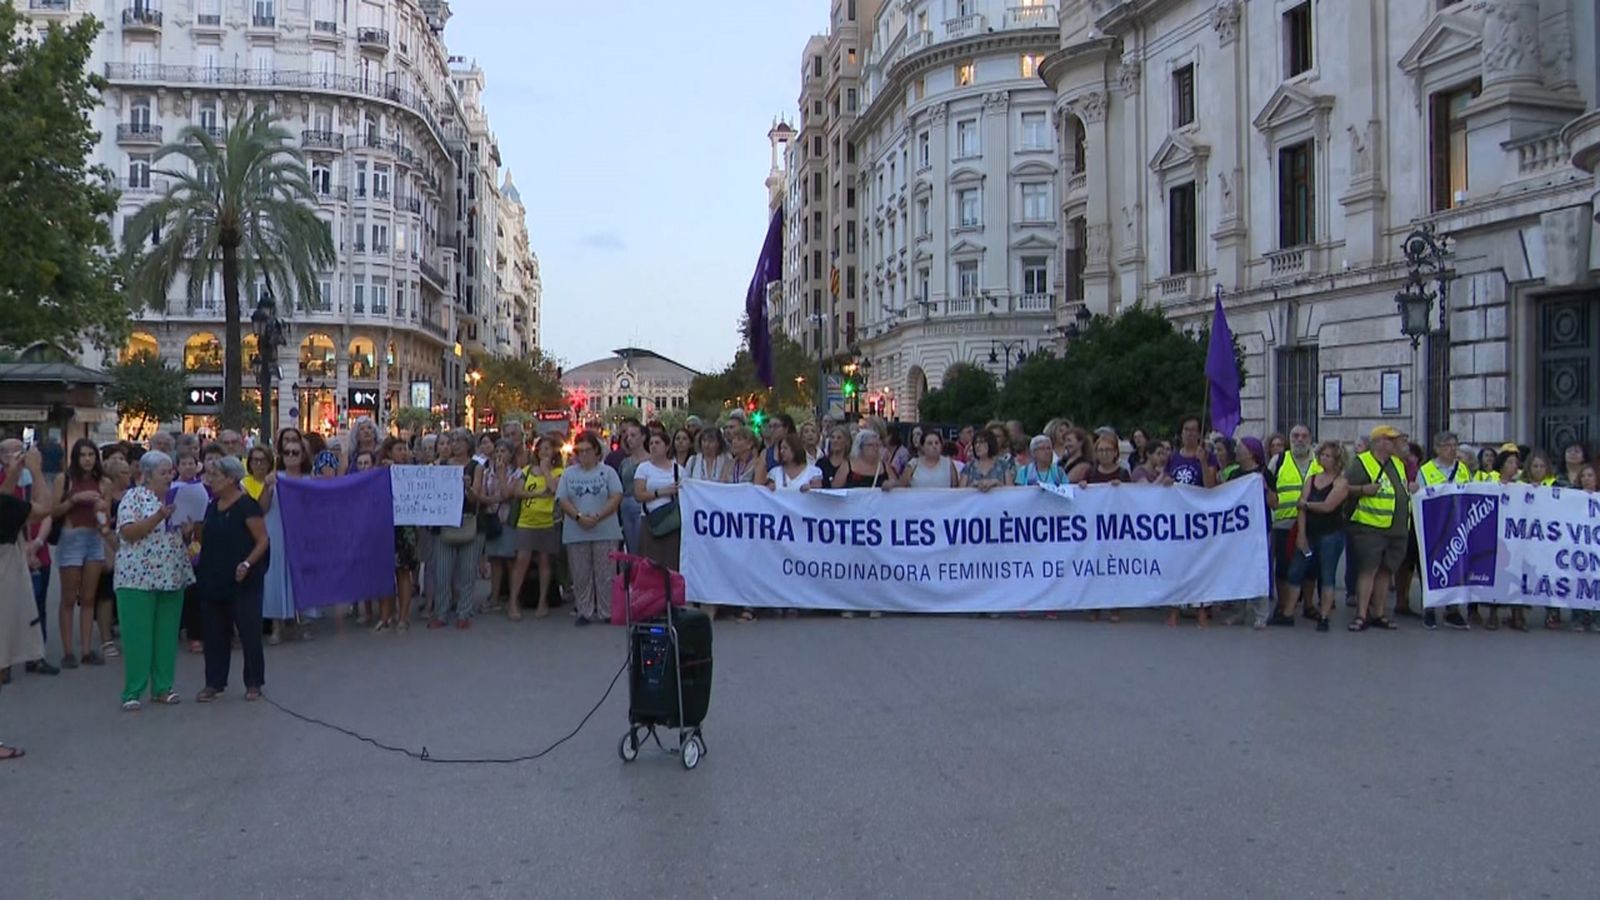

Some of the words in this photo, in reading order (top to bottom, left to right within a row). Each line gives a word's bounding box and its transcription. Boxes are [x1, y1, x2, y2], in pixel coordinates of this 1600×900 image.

[694, 510, 795, 542] CONTRA
[802, 517, 882, 546] TOTES
[891, 519, 935, 546] LES
[943, 511, 1087, 546] VIOLÈNCIES
[1096, 504, 1250, 541] MASCLISTES
[783, 558, 931, 582] COORDINADORA
[939, 561, 1034, 581] FEMINISTA
[1042, 560, 1064, 578] DE
[1072, 553, 1161, 577] VALÈNCIA
